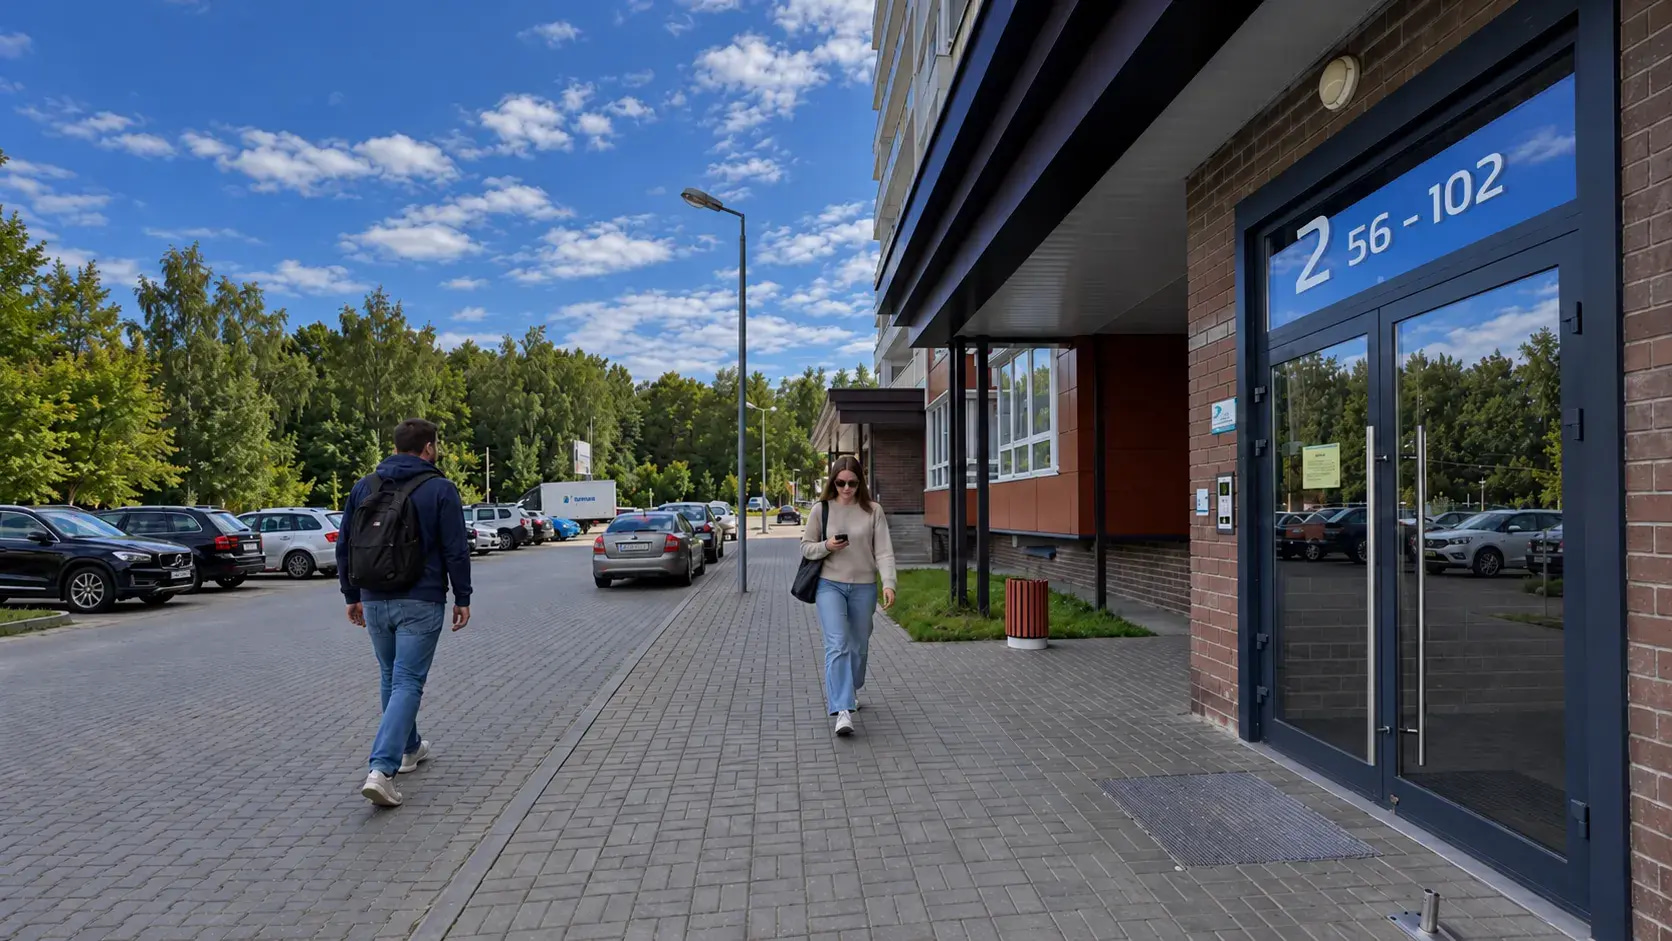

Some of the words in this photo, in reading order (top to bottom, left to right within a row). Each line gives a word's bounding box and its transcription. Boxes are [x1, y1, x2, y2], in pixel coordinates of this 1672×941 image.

[1296, 215, 1330, 294] 2
[1348, 212, 1391, 267] 56
[1429, 152, 1503, 224] 102
